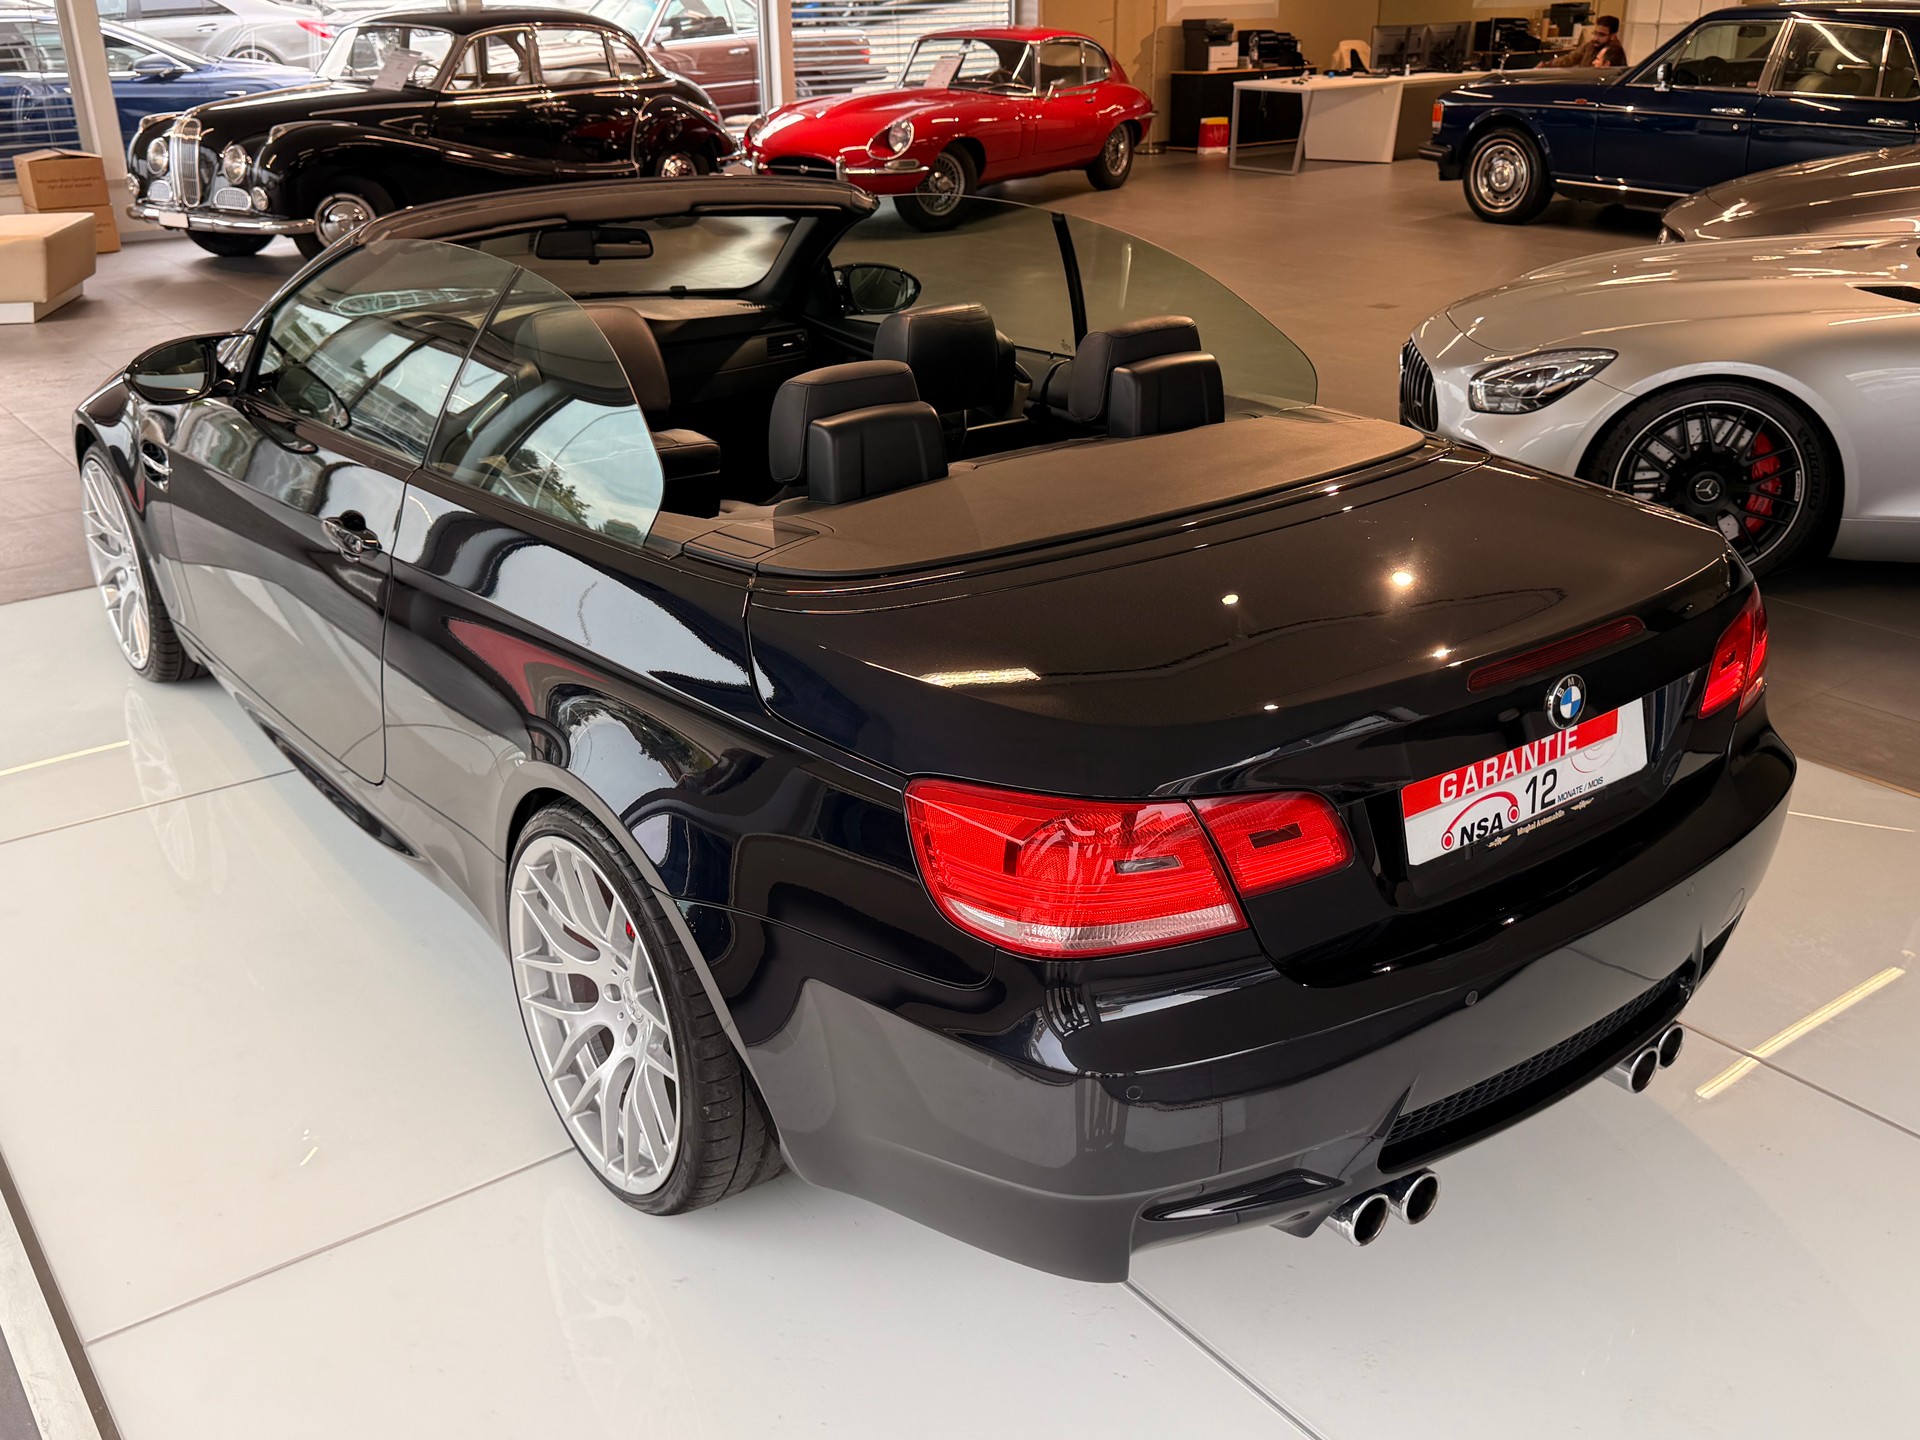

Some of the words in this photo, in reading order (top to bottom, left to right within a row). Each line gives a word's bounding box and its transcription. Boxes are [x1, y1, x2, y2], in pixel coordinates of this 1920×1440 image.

[1439, 725, 1579, 804] GARANTIE
[1525, 768, 1558, 815] 12
[1556, 785, 1583, 803] MONATE
[1587, 776, 1604, 789] MOIS
[1459, 812, 1504, 847] NSA
